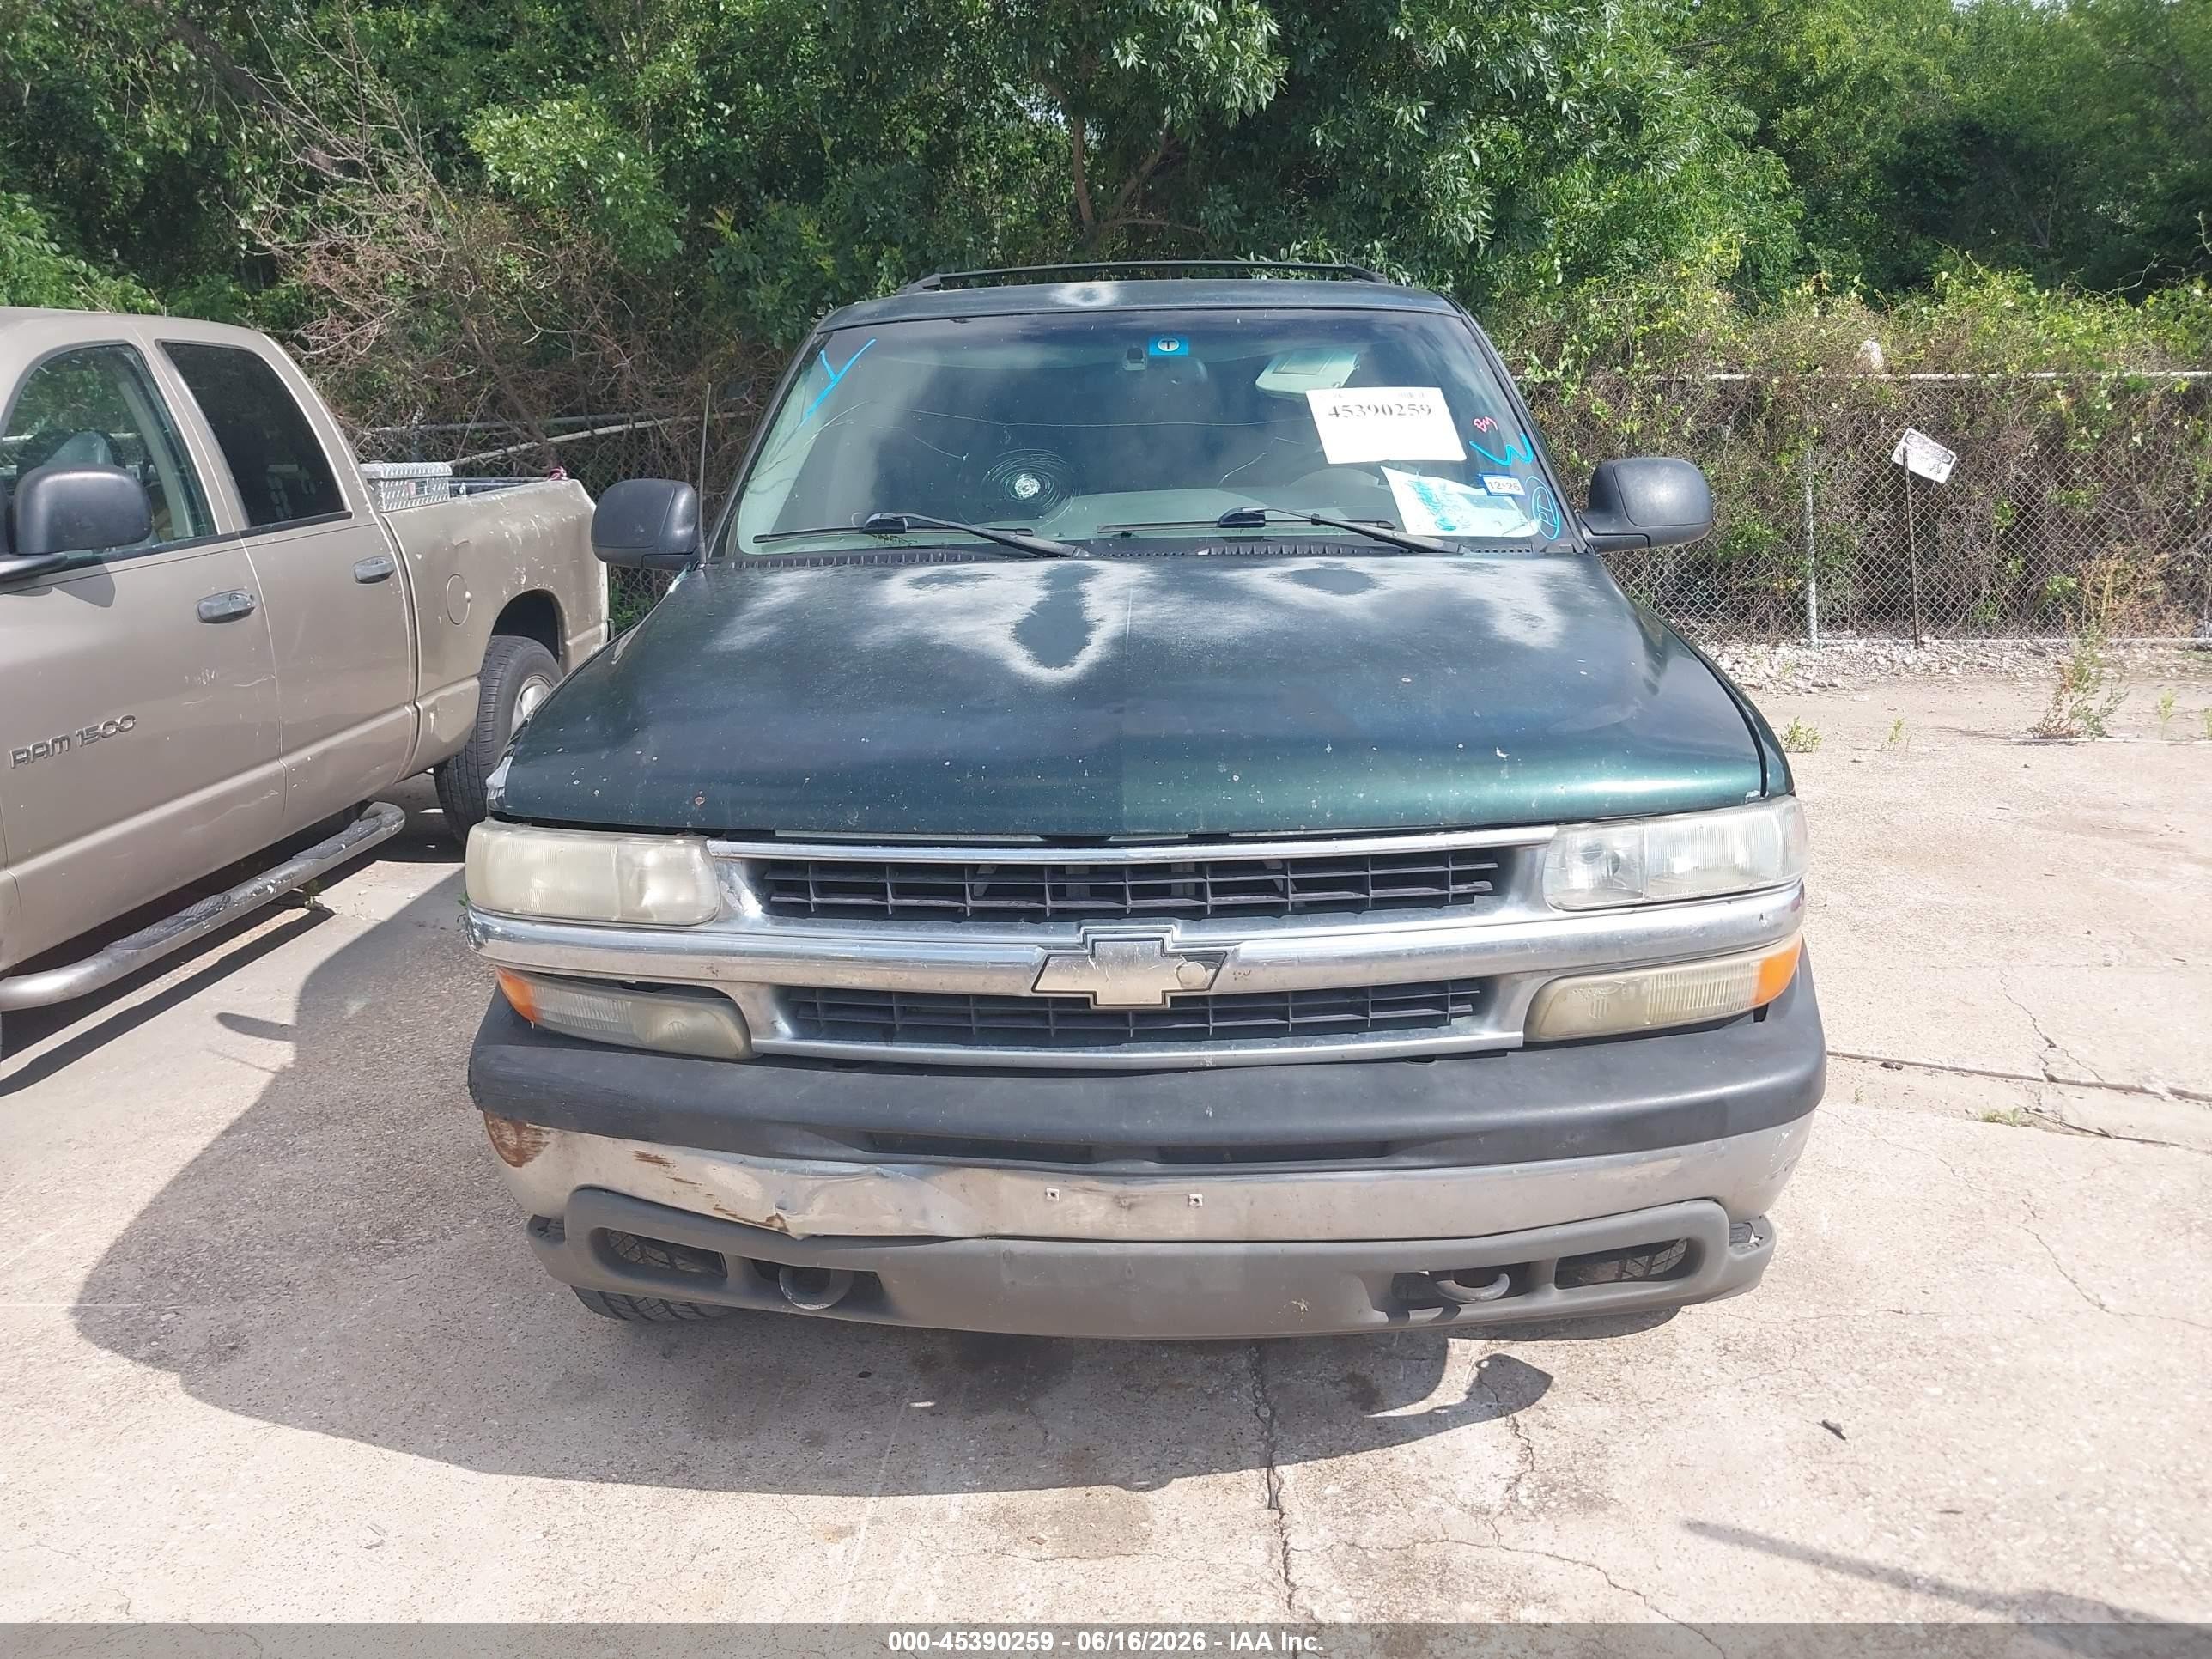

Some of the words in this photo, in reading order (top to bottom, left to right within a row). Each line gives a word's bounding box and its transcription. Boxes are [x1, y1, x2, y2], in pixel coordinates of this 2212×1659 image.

[1161, 339, 1176, 349] T
[1328, 403, 1432, 419] 45390259
[9, 734, 71, 769] RAM
[76, 714, 137, 748] 1500
